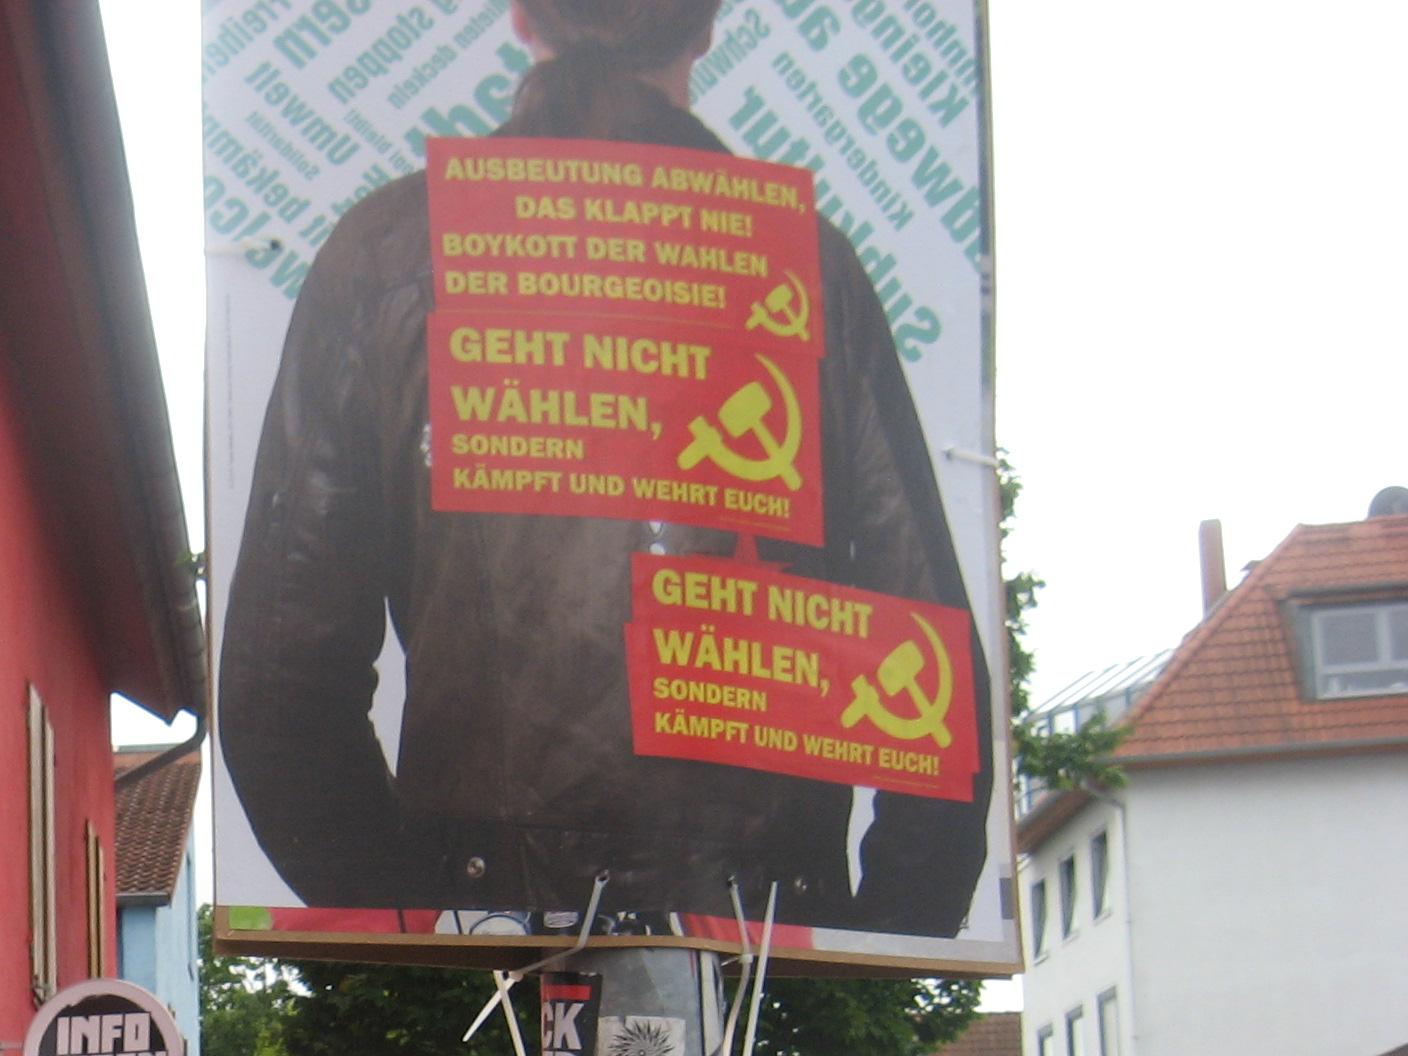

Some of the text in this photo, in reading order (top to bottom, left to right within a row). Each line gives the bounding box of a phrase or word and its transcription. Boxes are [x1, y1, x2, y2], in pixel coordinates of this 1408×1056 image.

[445, 158, 805, 214] AUSBEUTUNG ABWÄHLEN,
[516, 196, 752, 237] DAS KLAPPT NIE!
[443, 235, 768, 277] BOYKOTT DER WAHLEN
[445, 272, 727, 309] DER BOURGEOISIE!
[449, 327, 711, 380] GEHT NICHT
[450, 379, 663, 440] WÄHLEN,
[452, 434, 584, 460] SONDERN
[453, 464, 790, 518] KÄMPFT UND WEHRT EUCH!
[652, 569, 873, 639] GEHT NICHT
[653, 623, 831, 697] WÄHLEN,
[653, 677, 767, 712] SONDERN
[654, 709, 940, 776] KÄMPFT UND WEHRT EUCH!
[57, 1013, 150, 1056] INFO
